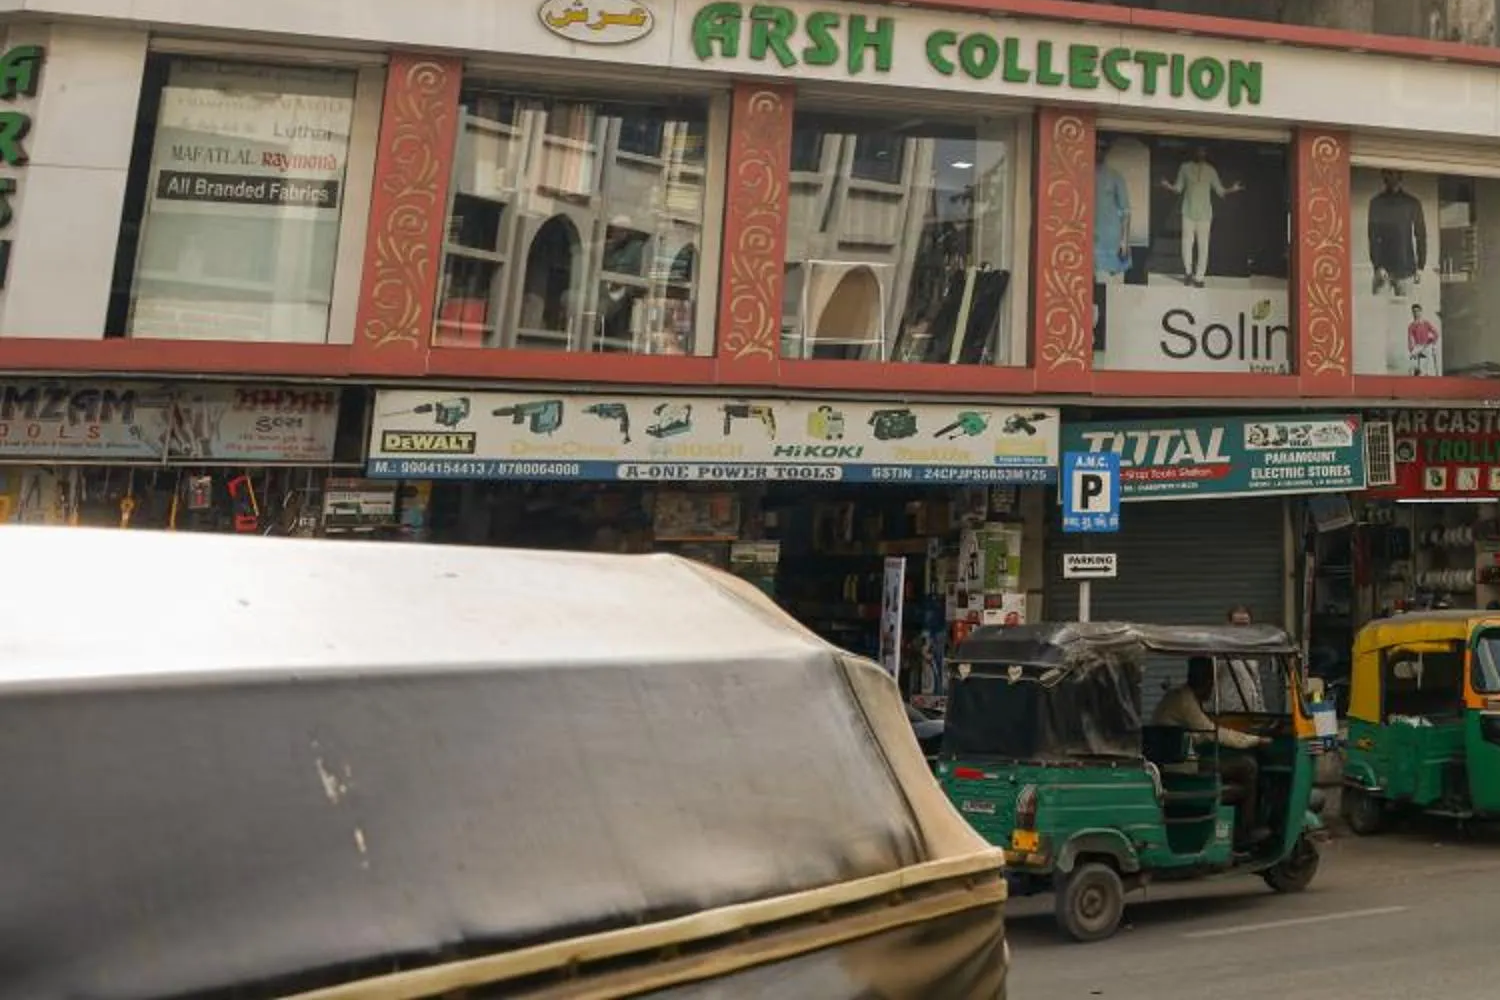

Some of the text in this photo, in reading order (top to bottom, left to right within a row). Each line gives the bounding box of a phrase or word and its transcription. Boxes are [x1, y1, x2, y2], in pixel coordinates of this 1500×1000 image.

[691, 1, 1263, 108] ARSH COLLECTION
[167, 176, 329, 202] All Branded Fabrics
[1264, 451, 1336, 464] PARAMOUNT
[625, 465, 837, 480] A-ONE POWER TOOLS
[1251, 464, 1351, 479] ELECTRIC STORES
[1080, 473, 1104, 510] P
[1067, 556, 1114, 565] PARKING
